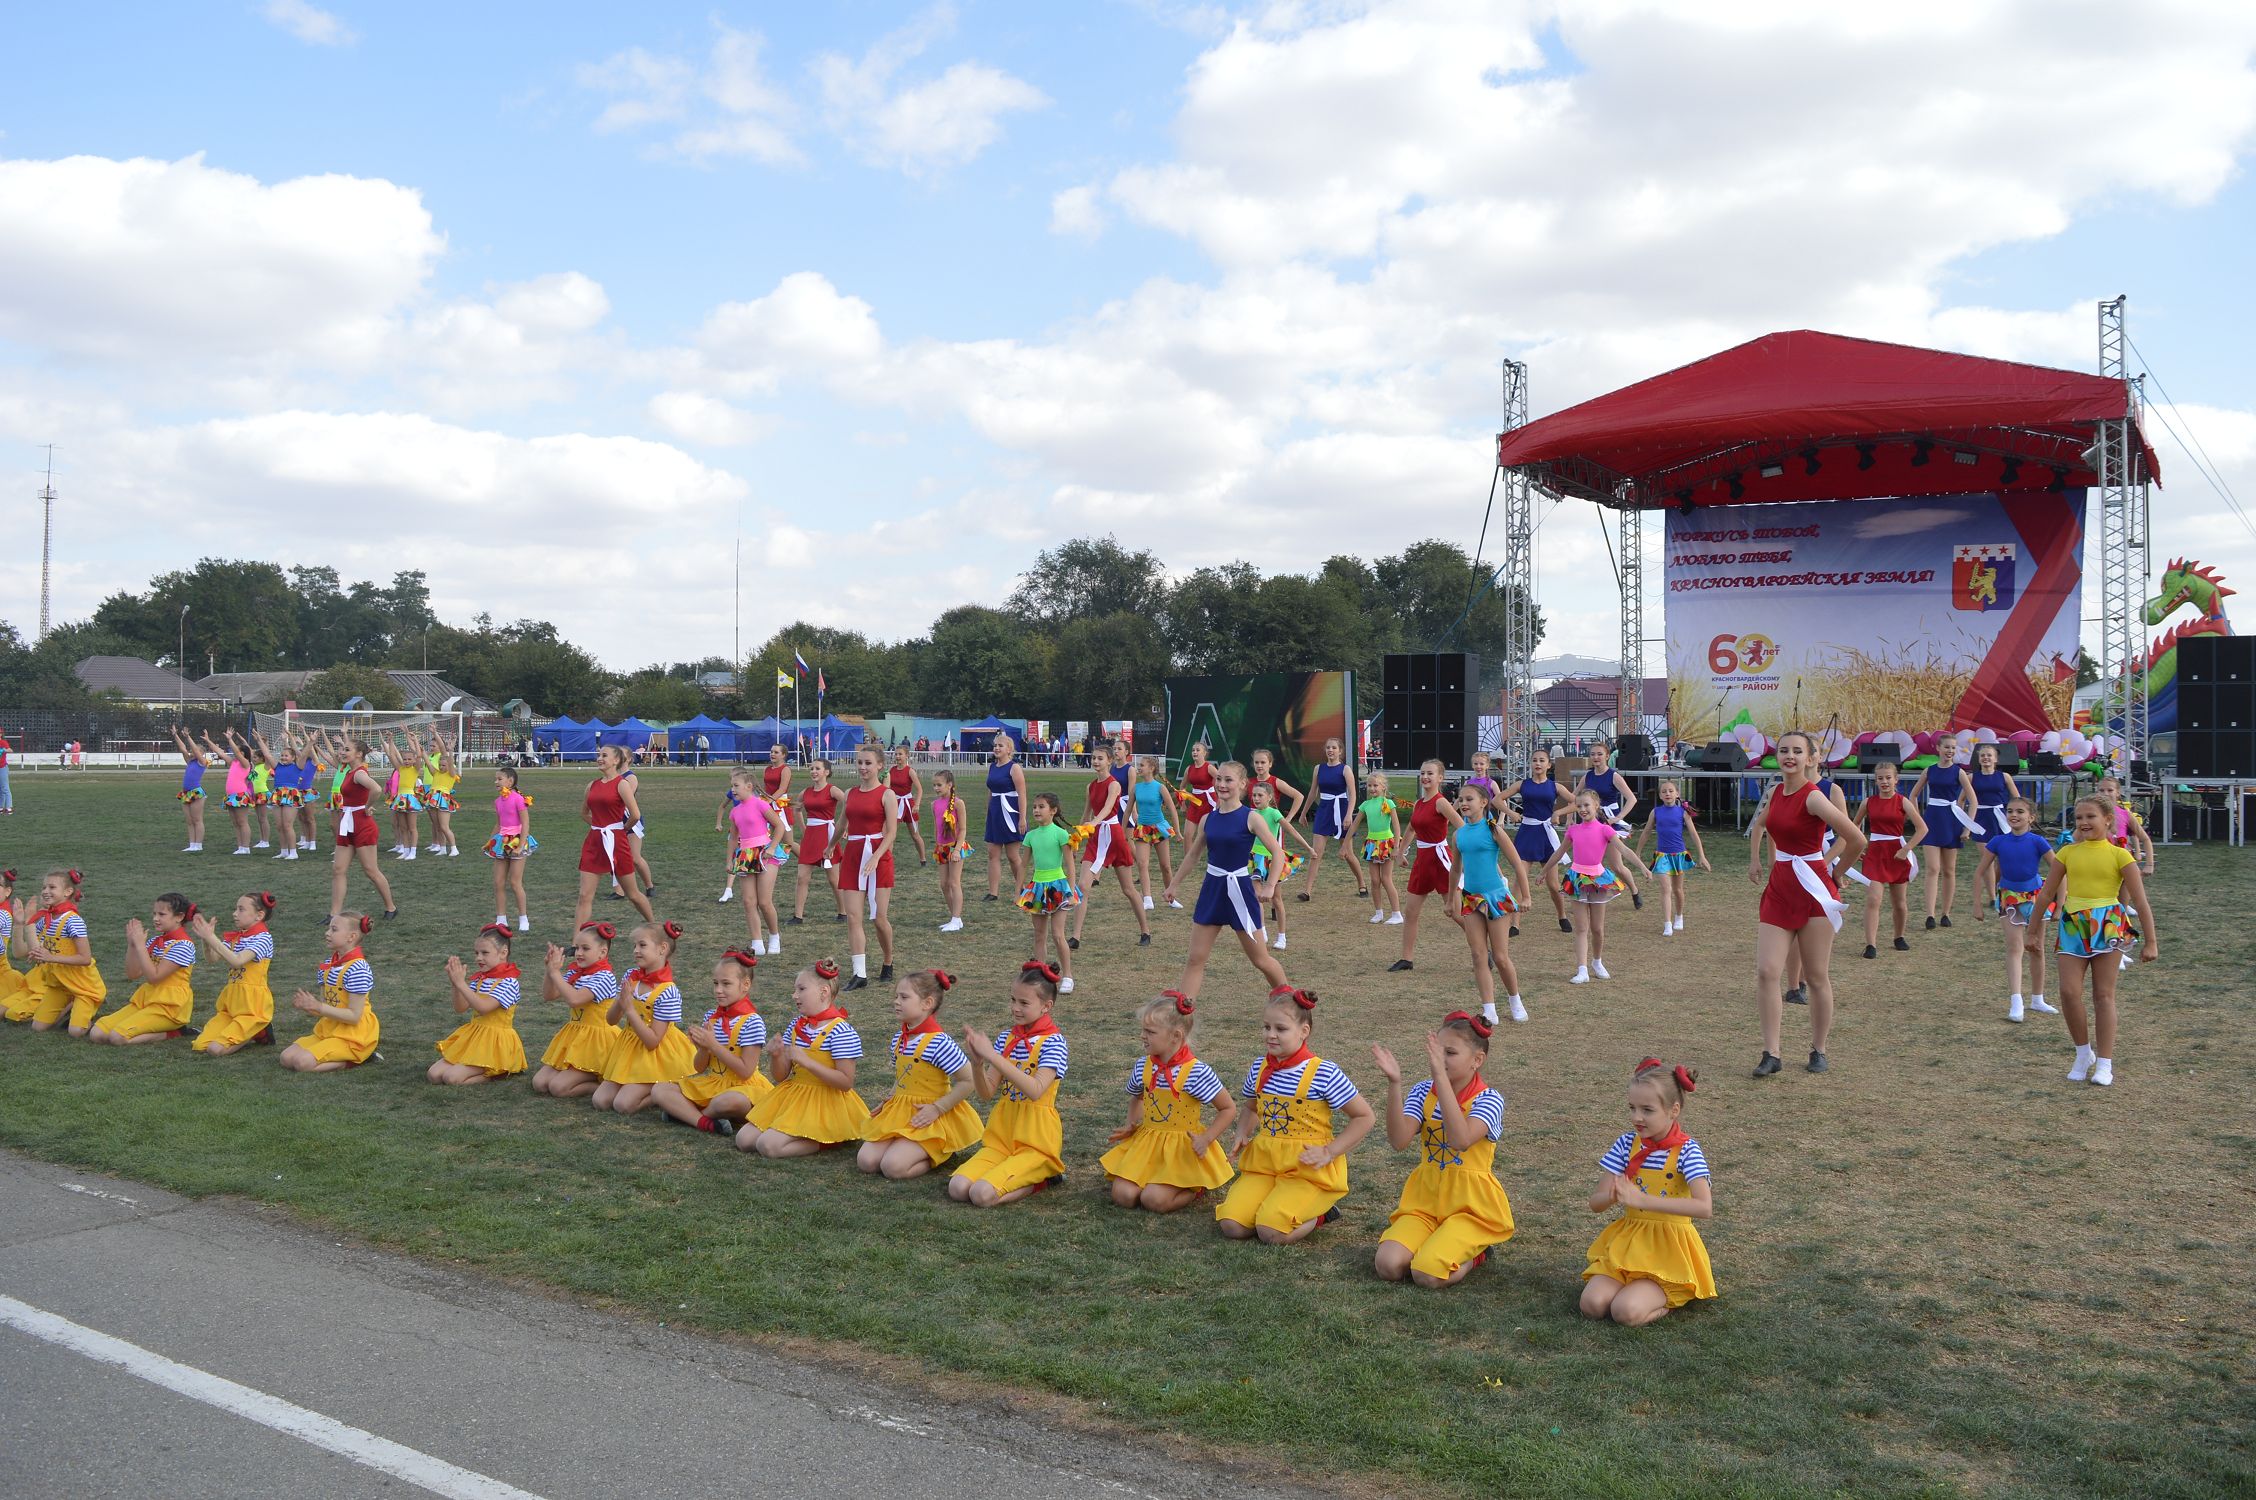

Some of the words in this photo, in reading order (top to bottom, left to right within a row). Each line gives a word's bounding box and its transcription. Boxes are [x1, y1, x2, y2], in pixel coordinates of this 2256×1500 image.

[1672, 529, 1749, 543] ГОРЖУСЬ
[1752, 523, 1821, 539] ТОБОЙ,
[1669, 554, 1737, 568] ЛЮБЛЮ
[1670, 571, 1864, 592] КРАСНОГВАРДЕЙСКАЯ
[1742, 681, 1779, 691] РАЙОНУ
